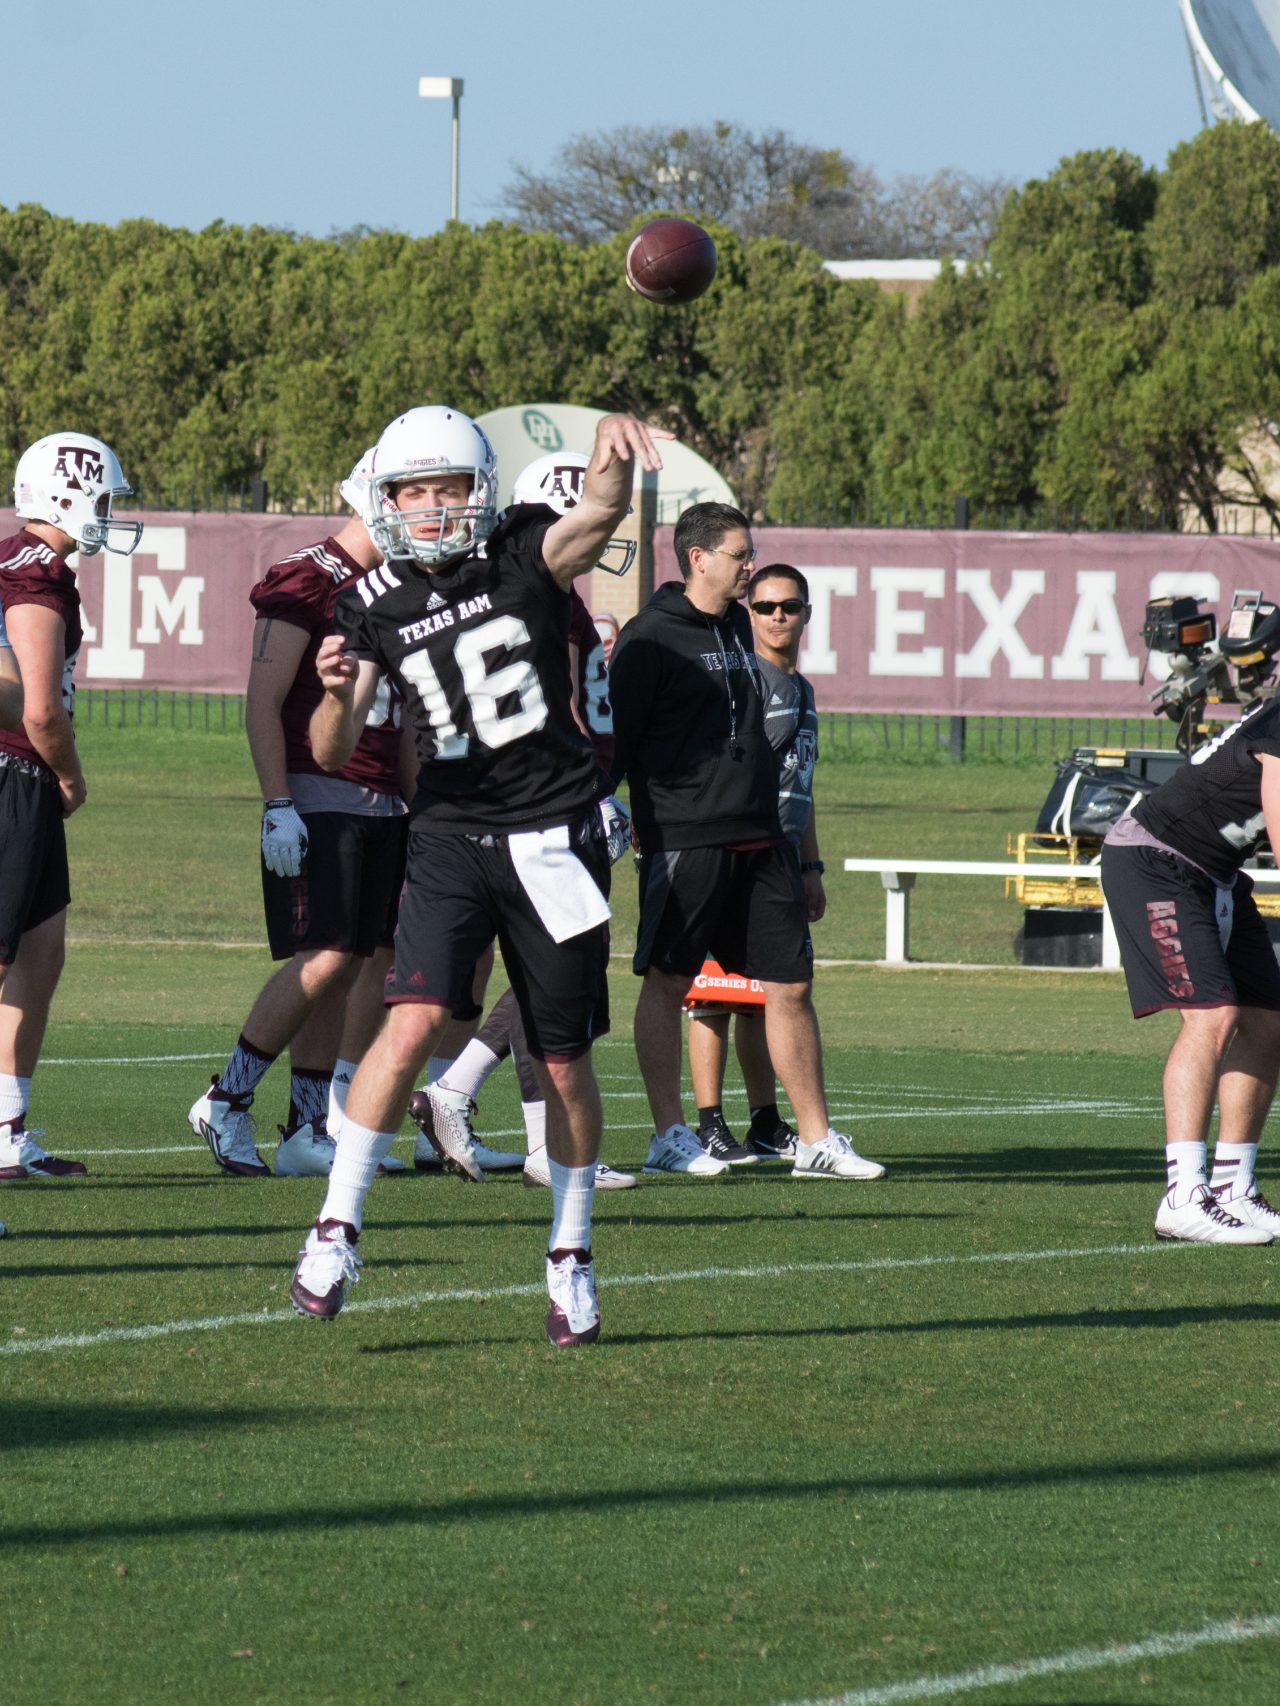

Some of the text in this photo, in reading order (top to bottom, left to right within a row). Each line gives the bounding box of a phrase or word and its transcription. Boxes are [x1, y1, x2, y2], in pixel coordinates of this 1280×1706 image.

[413, 458, 438, 466] AGGIES
[548, 465, 588, 509] AT
[398, 593, 493, 645] TEXAS A&M
[426, 600, 448, 611] adidas
[399, 614, 549, 760] 16
[1146, 900, 1195, 999] AGGIES
